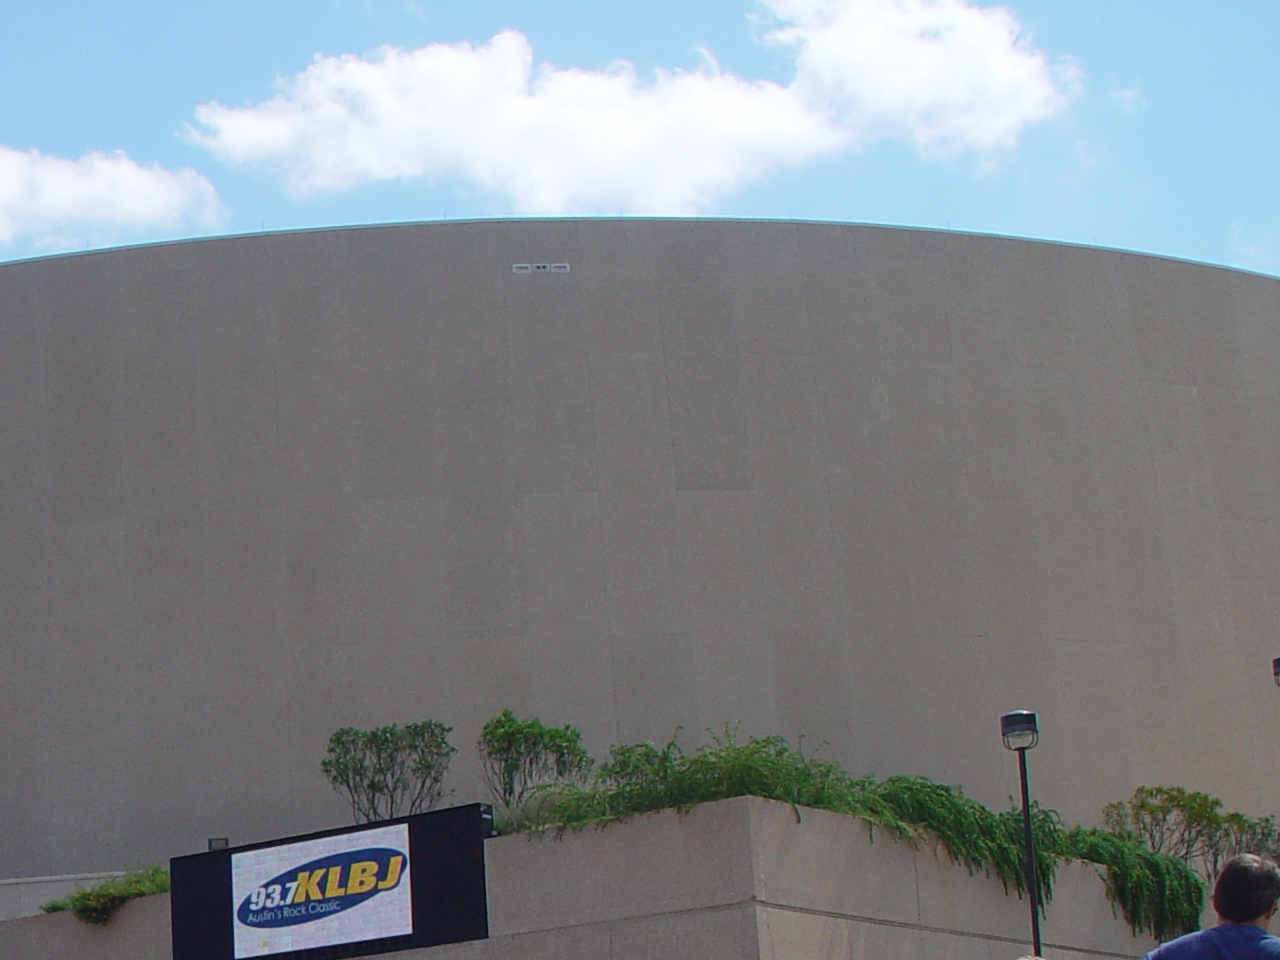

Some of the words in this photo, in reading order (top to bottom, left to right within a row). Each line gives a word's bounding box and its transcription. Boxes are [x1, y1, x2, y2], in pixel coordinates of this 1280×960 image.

[249, 880, 299, 910] 93.7
[293, 855, 403, 904] KLBJ
[246, 908, 282, 923] Austin's
[283, 904, 307, 919] Rock
[308, 899, 341, 914] Classic
